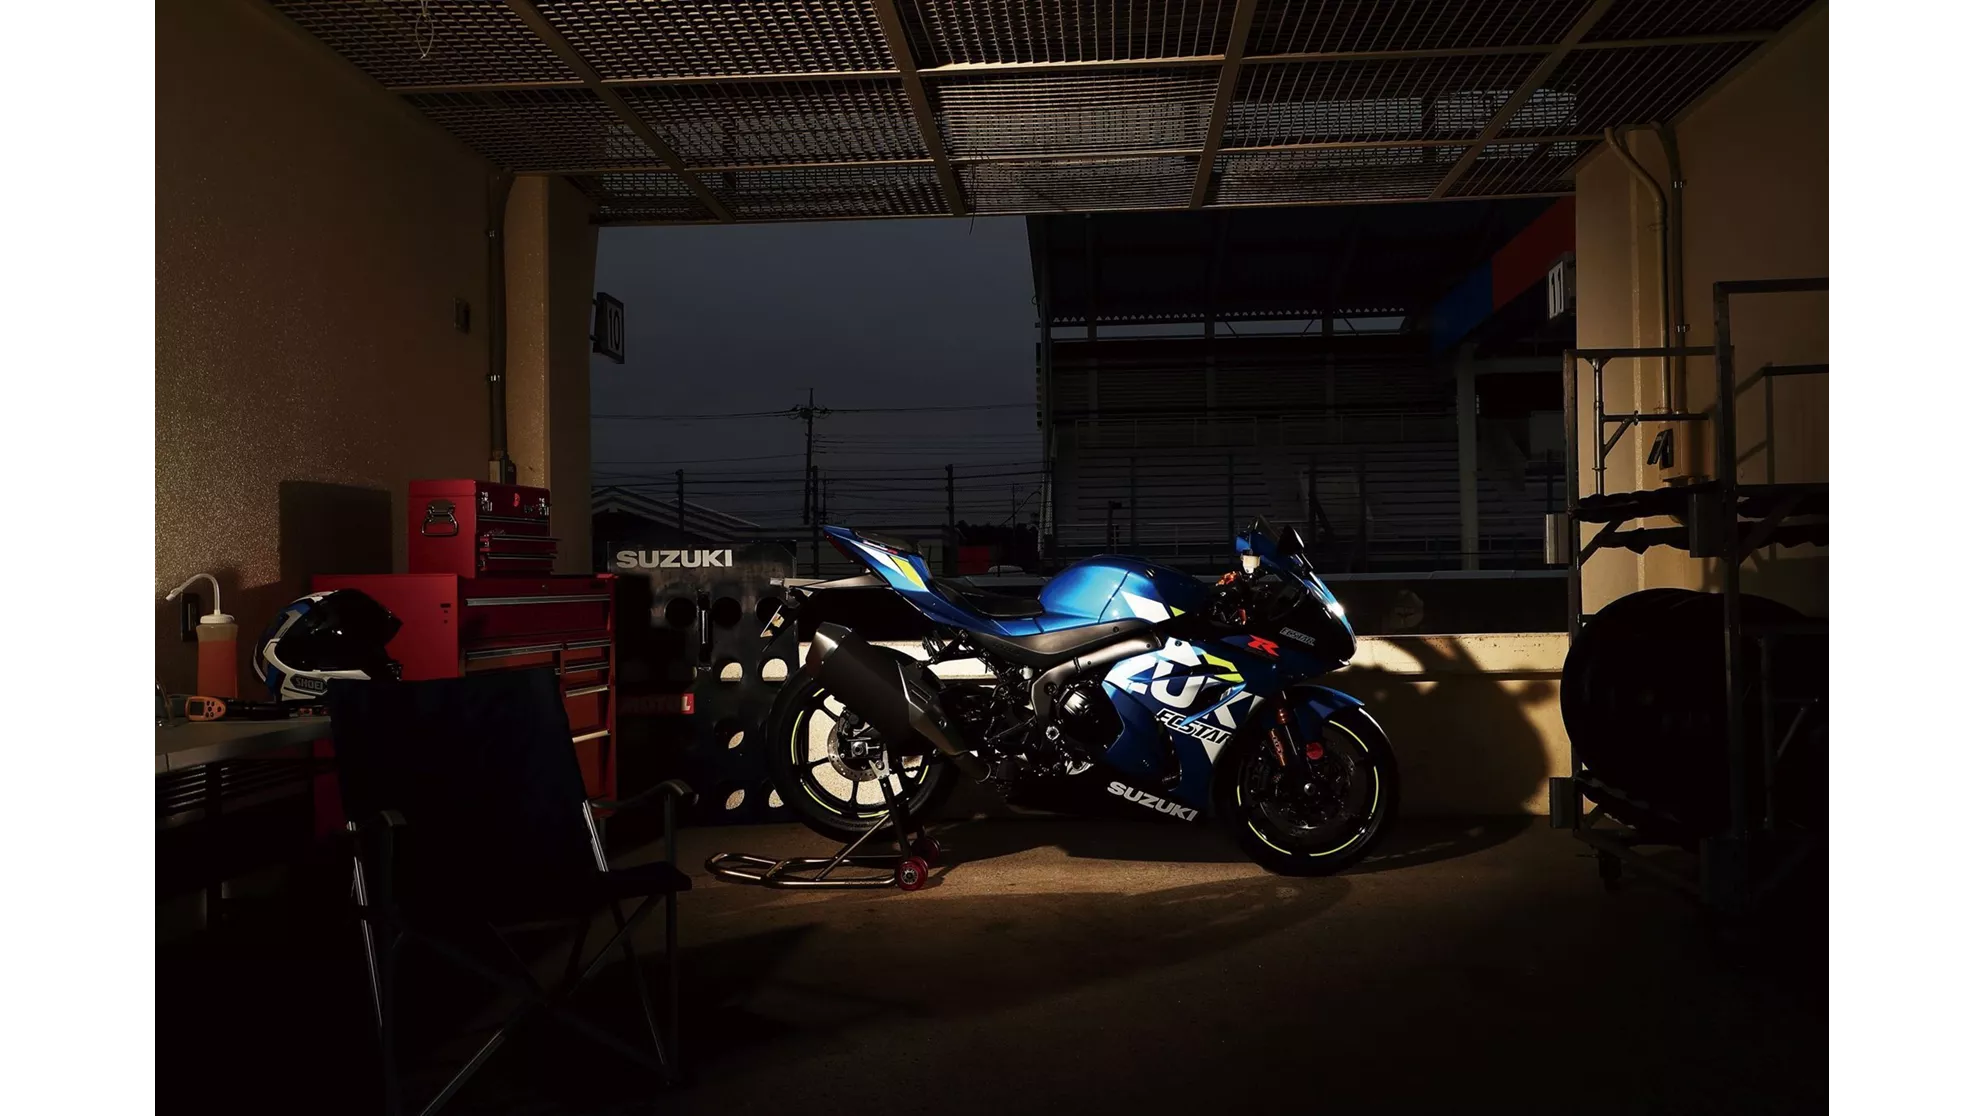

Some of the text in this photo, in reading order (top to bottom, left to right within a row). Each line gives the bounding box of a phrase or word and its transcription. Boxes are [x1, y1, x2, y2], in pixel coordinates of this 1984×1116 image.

[1551, 267, 1562, 314] 11
[609, 308, 620, 350] 10
[616, 549, 733, 568] SUZUKI
[1247, 633, 1280, 657] R
[295, 677, 324, 690] SHOEI
[1107, 781, 1199, 822] SUZUKI
